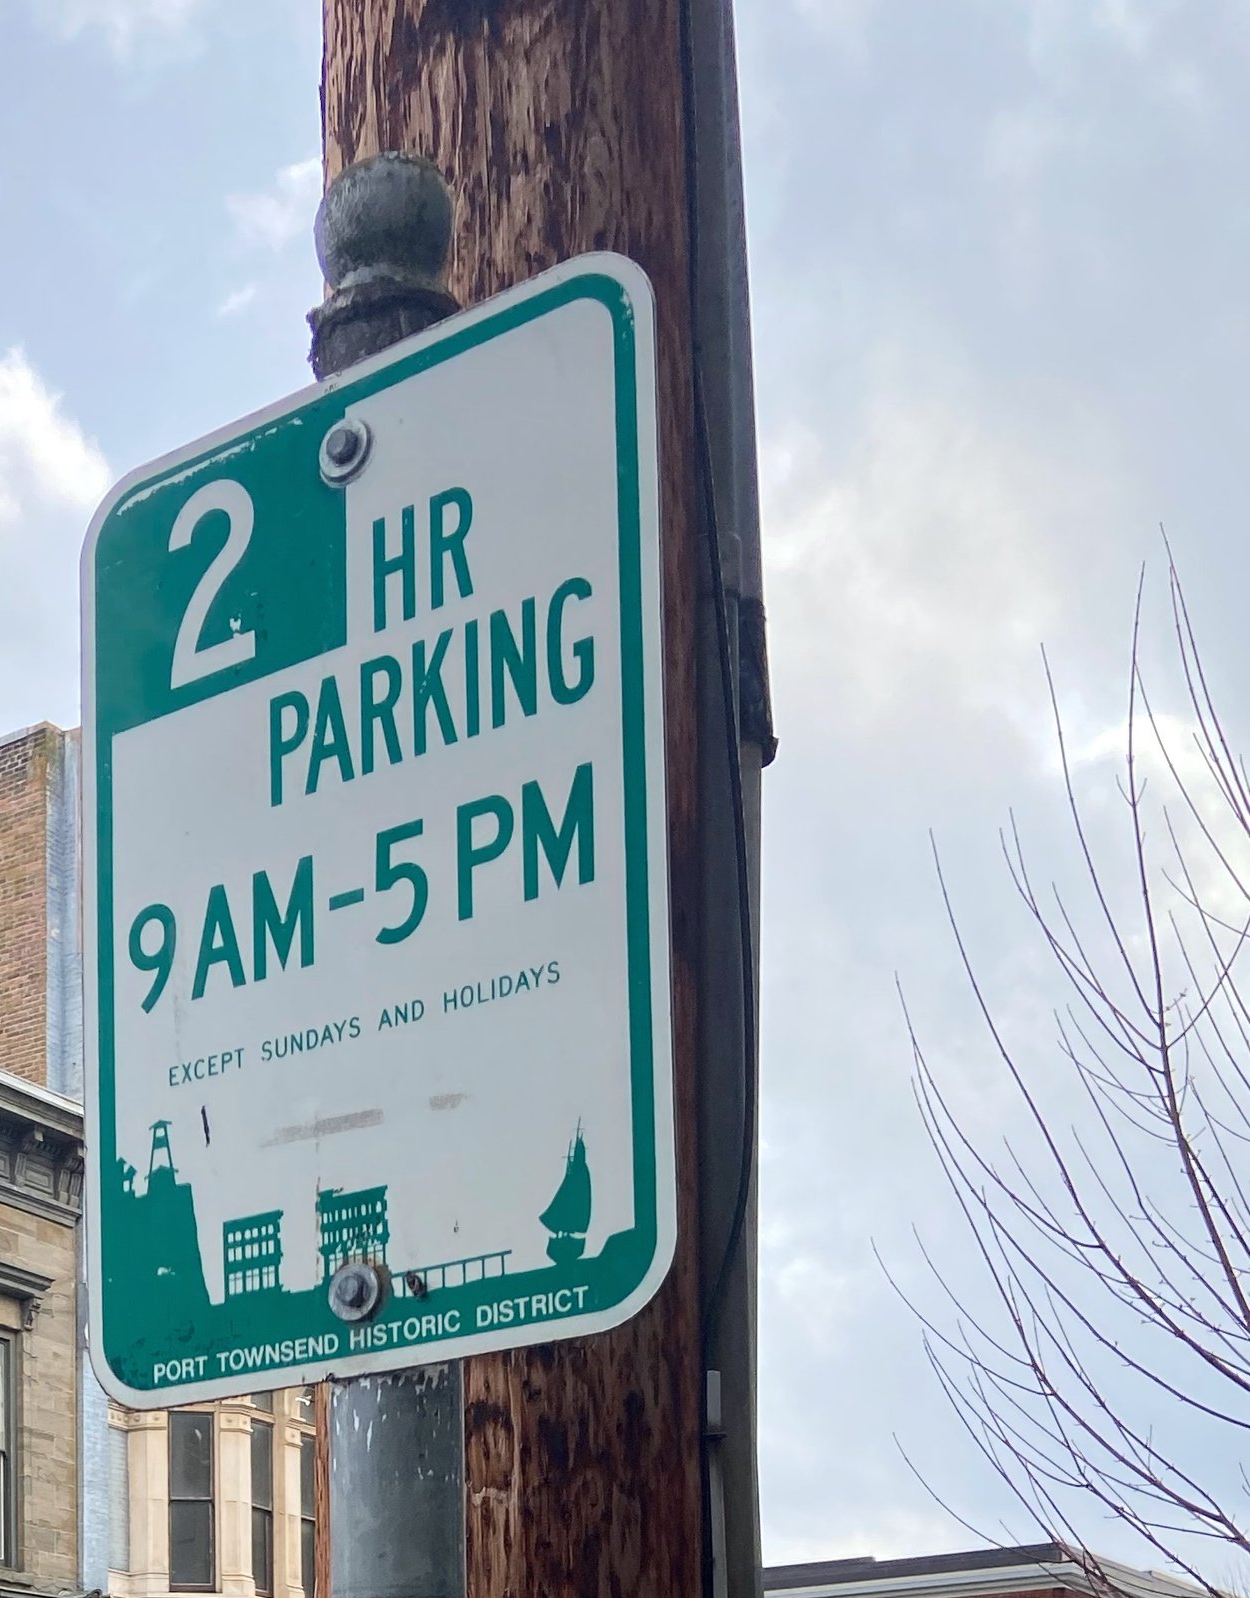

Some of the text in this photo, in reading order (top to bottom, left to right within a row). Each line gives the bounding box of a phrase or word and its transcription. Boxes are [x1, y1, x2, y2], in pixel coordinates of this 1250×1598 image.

[168, 478, 474, 692] 2 HR
[268, 577, 596, 808] PARKING
[167, 961, 562, 1087] EXCEPT SUNDAYS AND HOLIDAYS
[153, 1285, 590, 1385] PORT TOWNSEND HISTORIC DISTRICT
